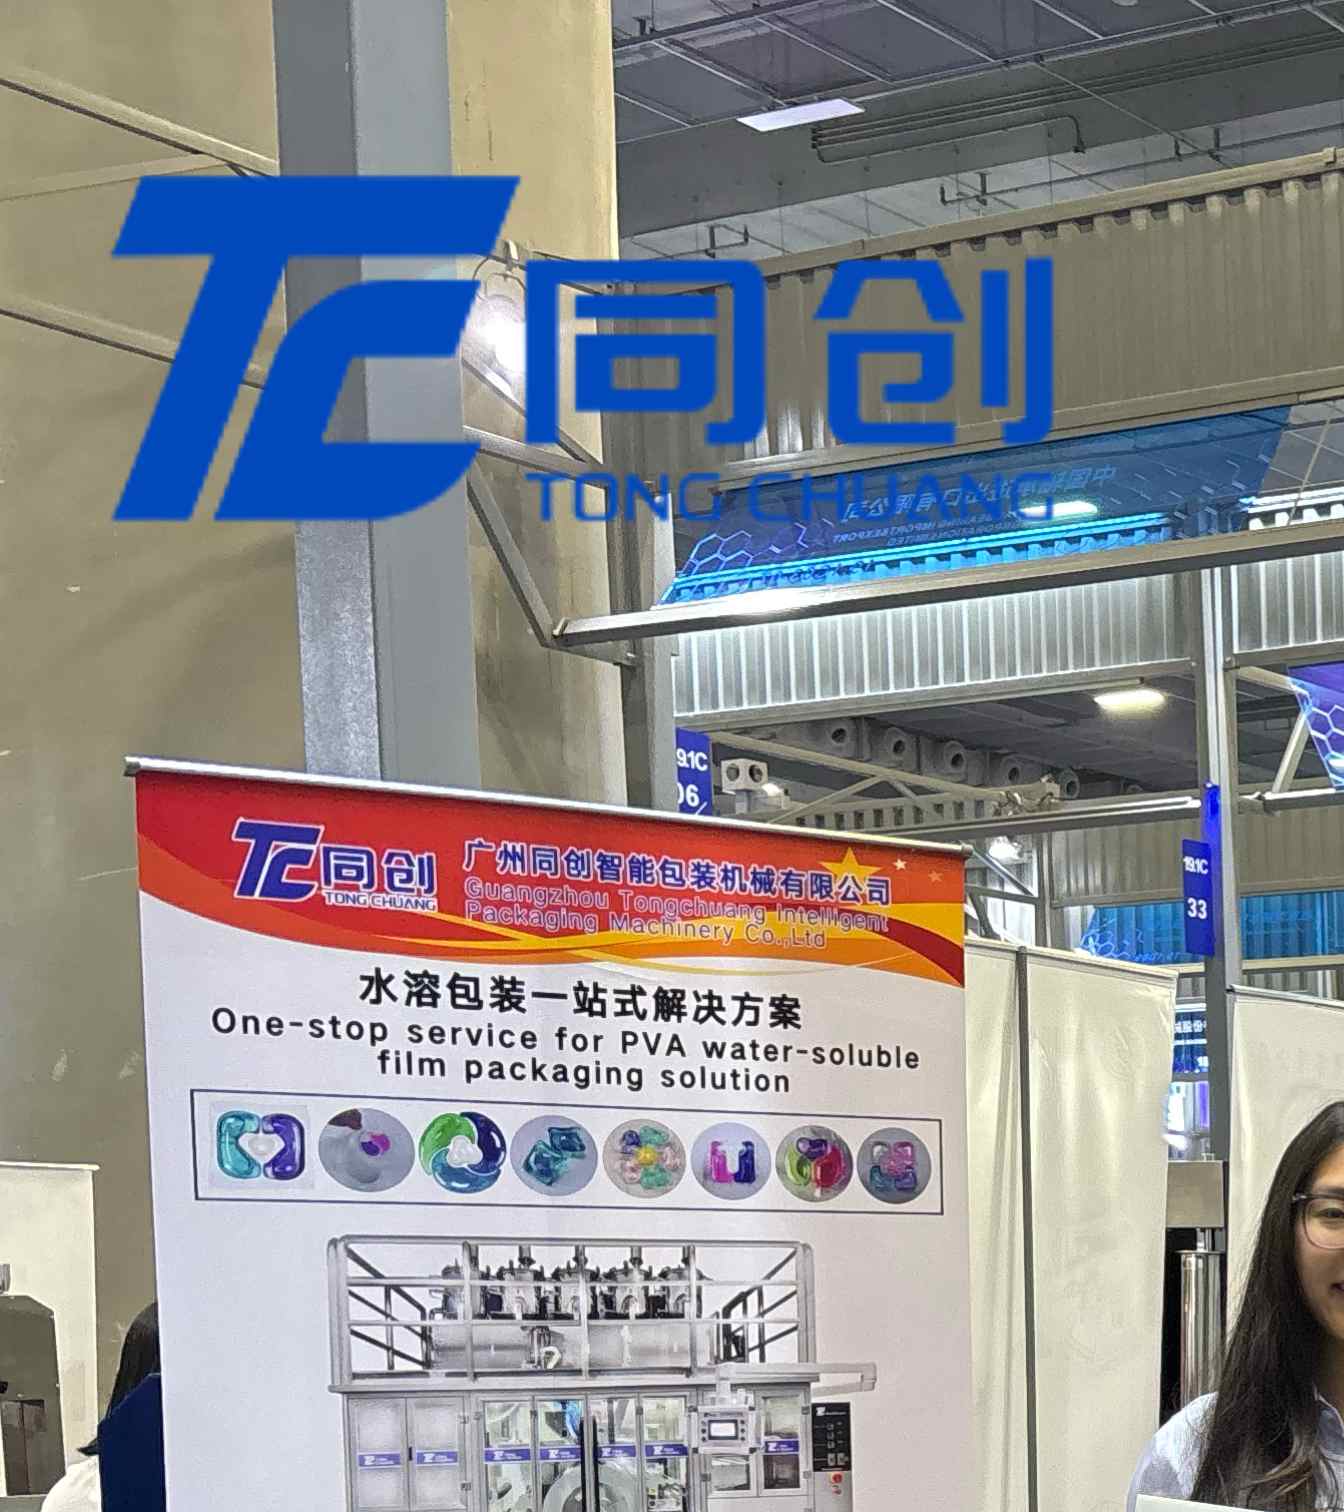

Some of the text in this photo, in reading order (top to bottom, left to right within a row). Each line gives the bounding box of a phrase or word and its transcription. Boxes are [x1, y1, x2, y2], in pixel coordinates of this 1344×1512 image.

[321, 845, 436, 894] 同创
[463, 838, 892, 906] 广州同创智能包装机械有限公司
[325, 891, 437, 911] TONG CHUANG
[465, 877, 887, 932] Guangzhou Tongchuang Intelligent
[465, 902, 597, 933] Packaging
[610, 913, 733, 945] Machinery
[1187, 897, 1207, 919] 33
[359, 966, 803, 1030] 水溶包装一站式解决方案
[211, 1007, 920, 1069] One-stop service for PVA water-soluble
[378, 1049, 790, 1093] film packaging solution
